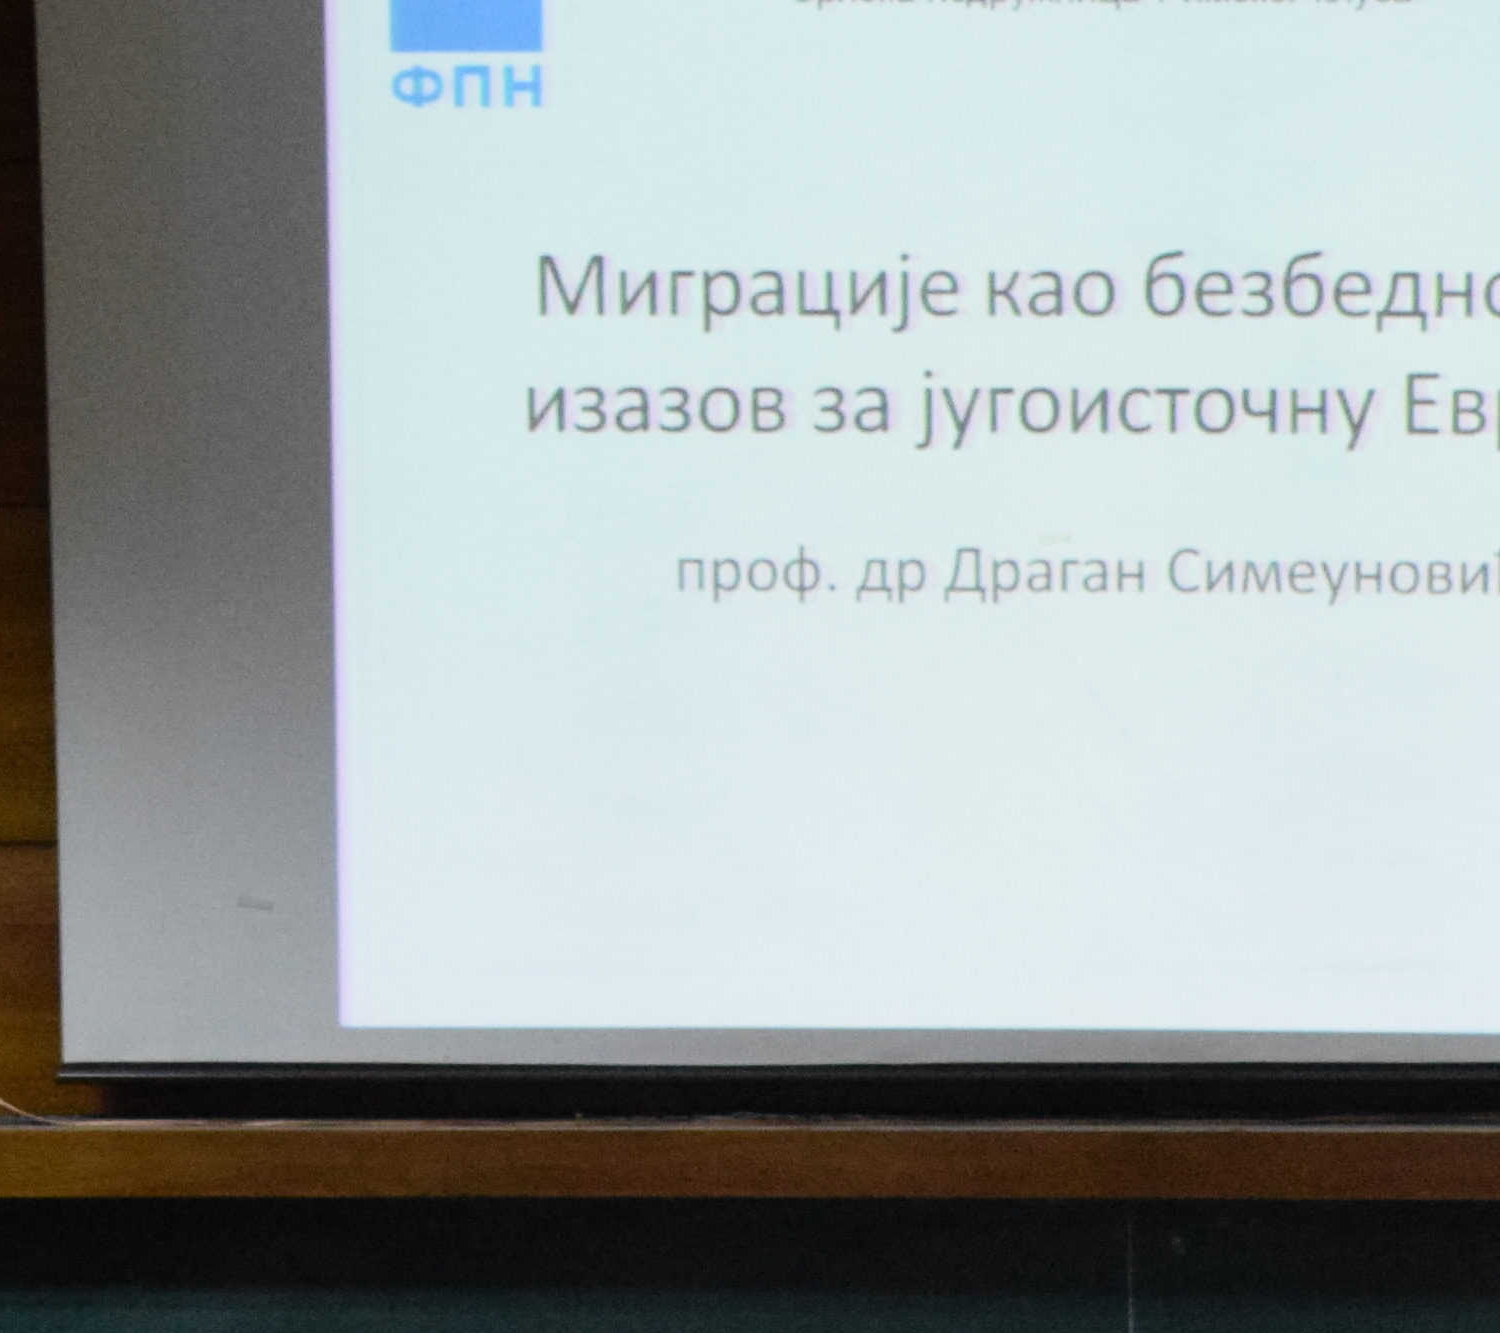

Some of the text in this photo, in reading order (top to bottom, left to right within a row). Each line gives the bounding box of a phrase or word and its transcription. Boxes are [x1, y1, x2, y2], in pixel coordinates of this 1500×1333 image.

[391, 65, 542, 108] ФПН
[536, 251, 961, 334] Миграције
[986, 268, 1117, 318] као
[525, 384, 788, 434] изазов
[812, 384, 891, 434] за
[913, 369, 1377, 452] југоисточну
[676, 543, 838, 604] проф.
[854, 557, 928, 604] др
[942, 545, 1147, 605] Драган
